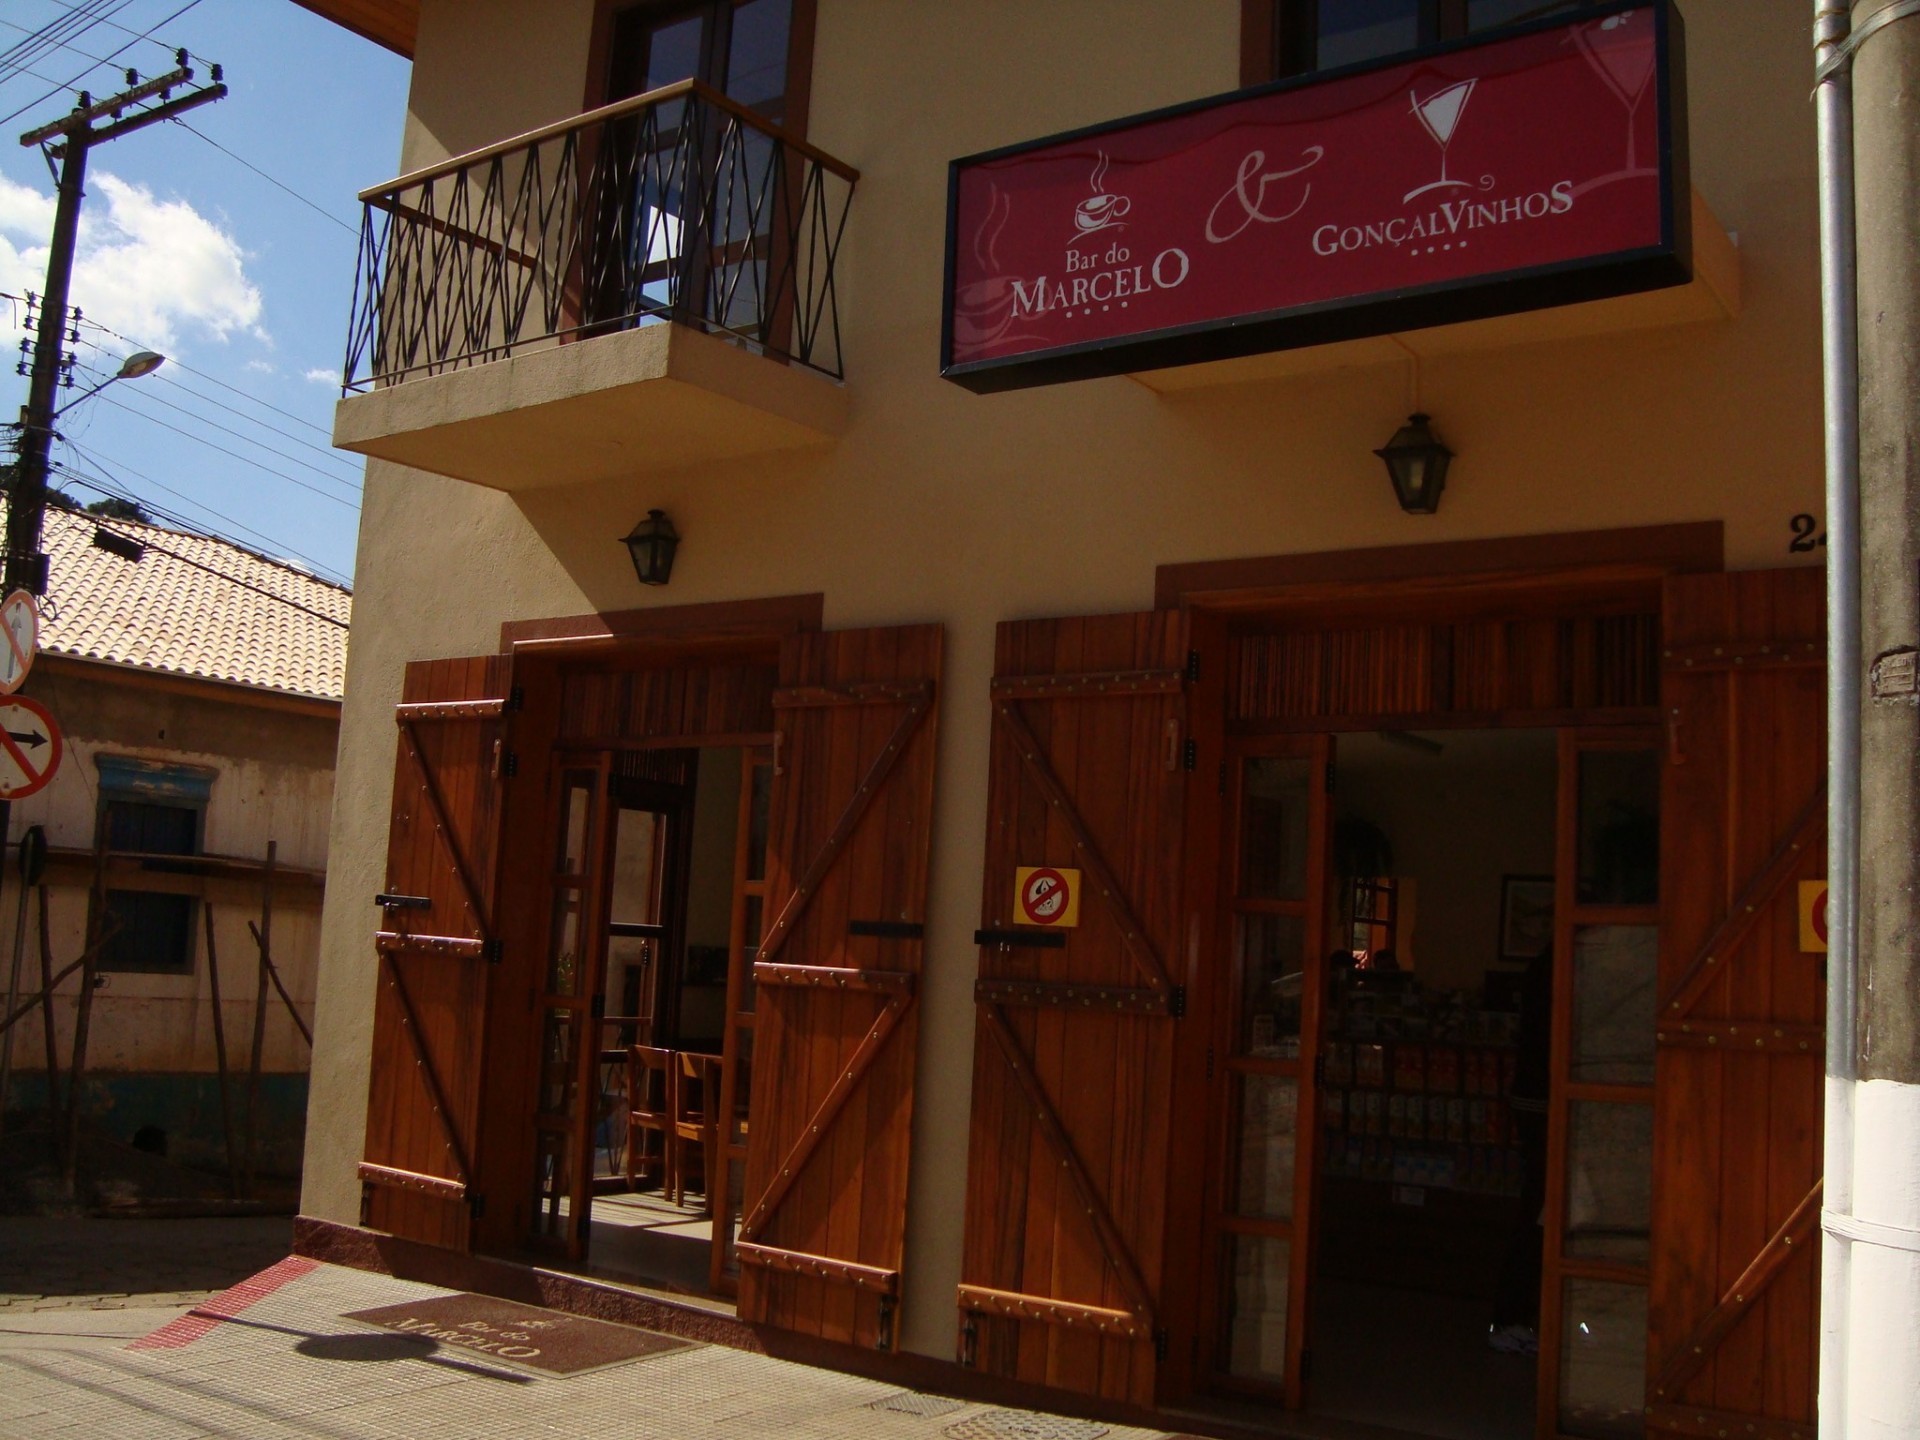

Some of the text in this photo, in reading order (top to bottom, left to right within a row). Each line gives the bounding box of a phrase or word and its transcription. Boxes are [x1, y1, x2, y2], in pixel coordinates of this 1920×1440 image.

[1205, 145, 1324, 244] &
[1312, 180, 1573, 256] GONÇALVINHOS
[1010, 248, 1190, 318] MARCELO
[1065, 242, 1130, 273] Bar do
[1789, 513, 1827, 553] 2
